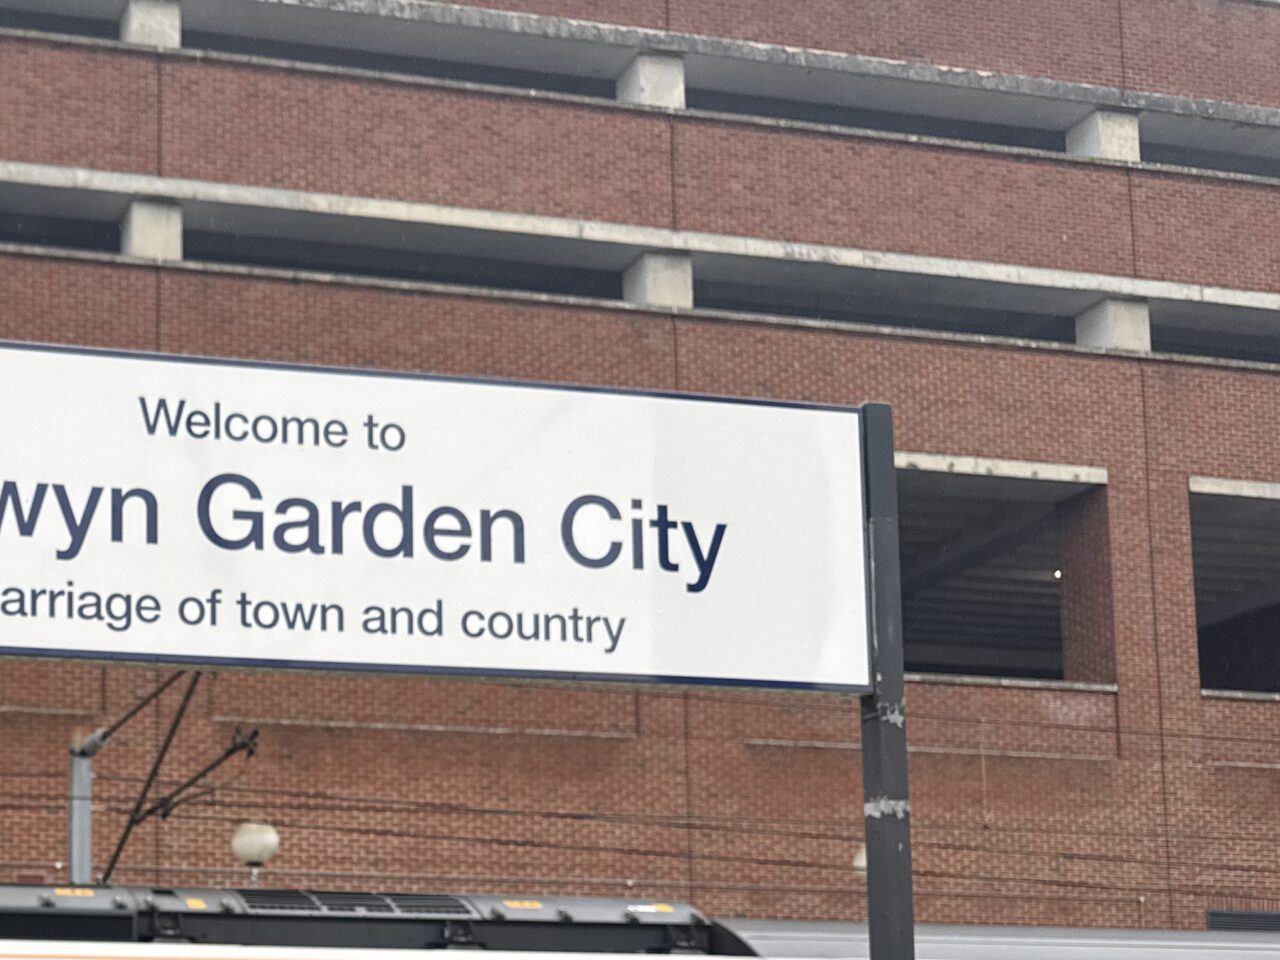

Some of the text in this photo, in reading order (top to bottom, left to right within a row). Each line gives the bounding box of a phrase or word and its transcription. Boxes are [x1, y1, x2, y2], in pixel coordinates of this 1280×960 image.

[138, 396, 406, 451] Welcome to
[197, 473, 526, 564] Garden
[561, 494, 728, 593] City
[178, 589, 222, 626] of
[237, 592, 344, 632] town
[362, 600, 443, 636] and
[460, 606, 627, 653] country
